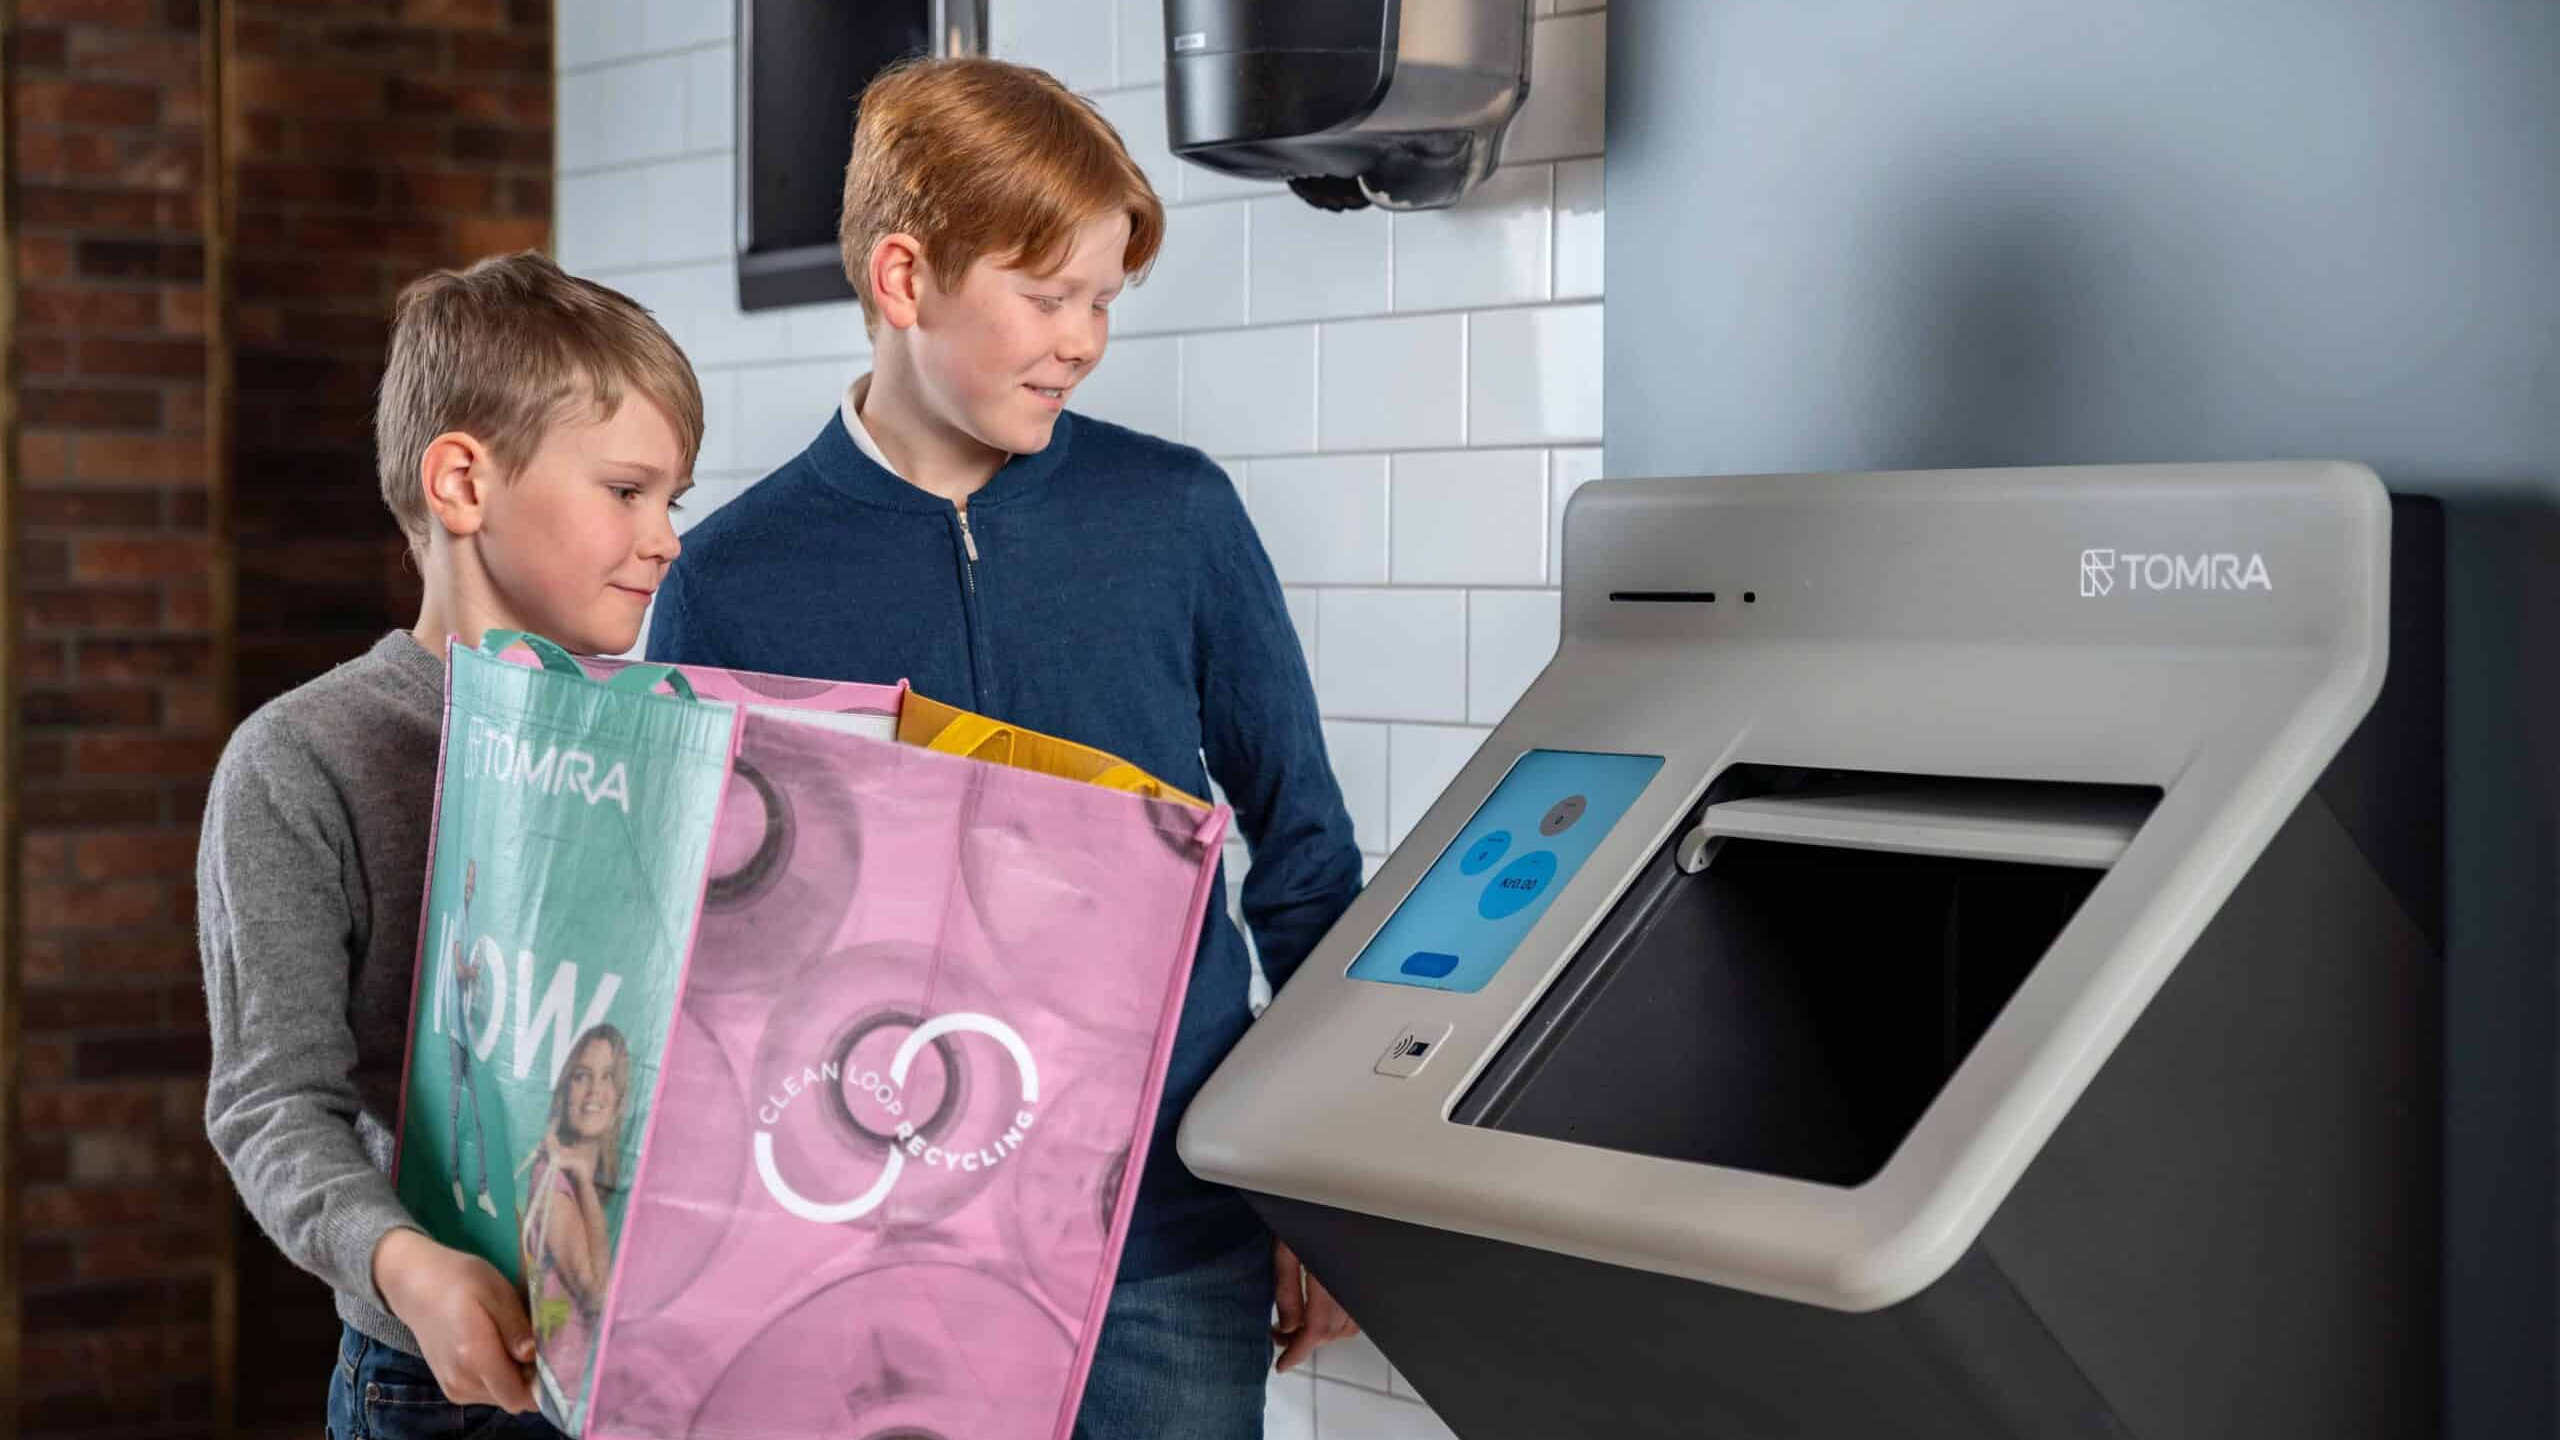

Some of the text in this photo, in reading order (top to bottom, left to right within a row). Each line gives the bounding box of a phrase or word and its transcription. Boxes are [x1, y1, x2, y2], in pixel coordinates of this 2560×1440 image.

[2120, 553, 2273, 590] TOMRA
[484, 727, 630, 814] TOMRA
[758, 1061, 1034, 1172] CLEAN LOOP RECYCLING
